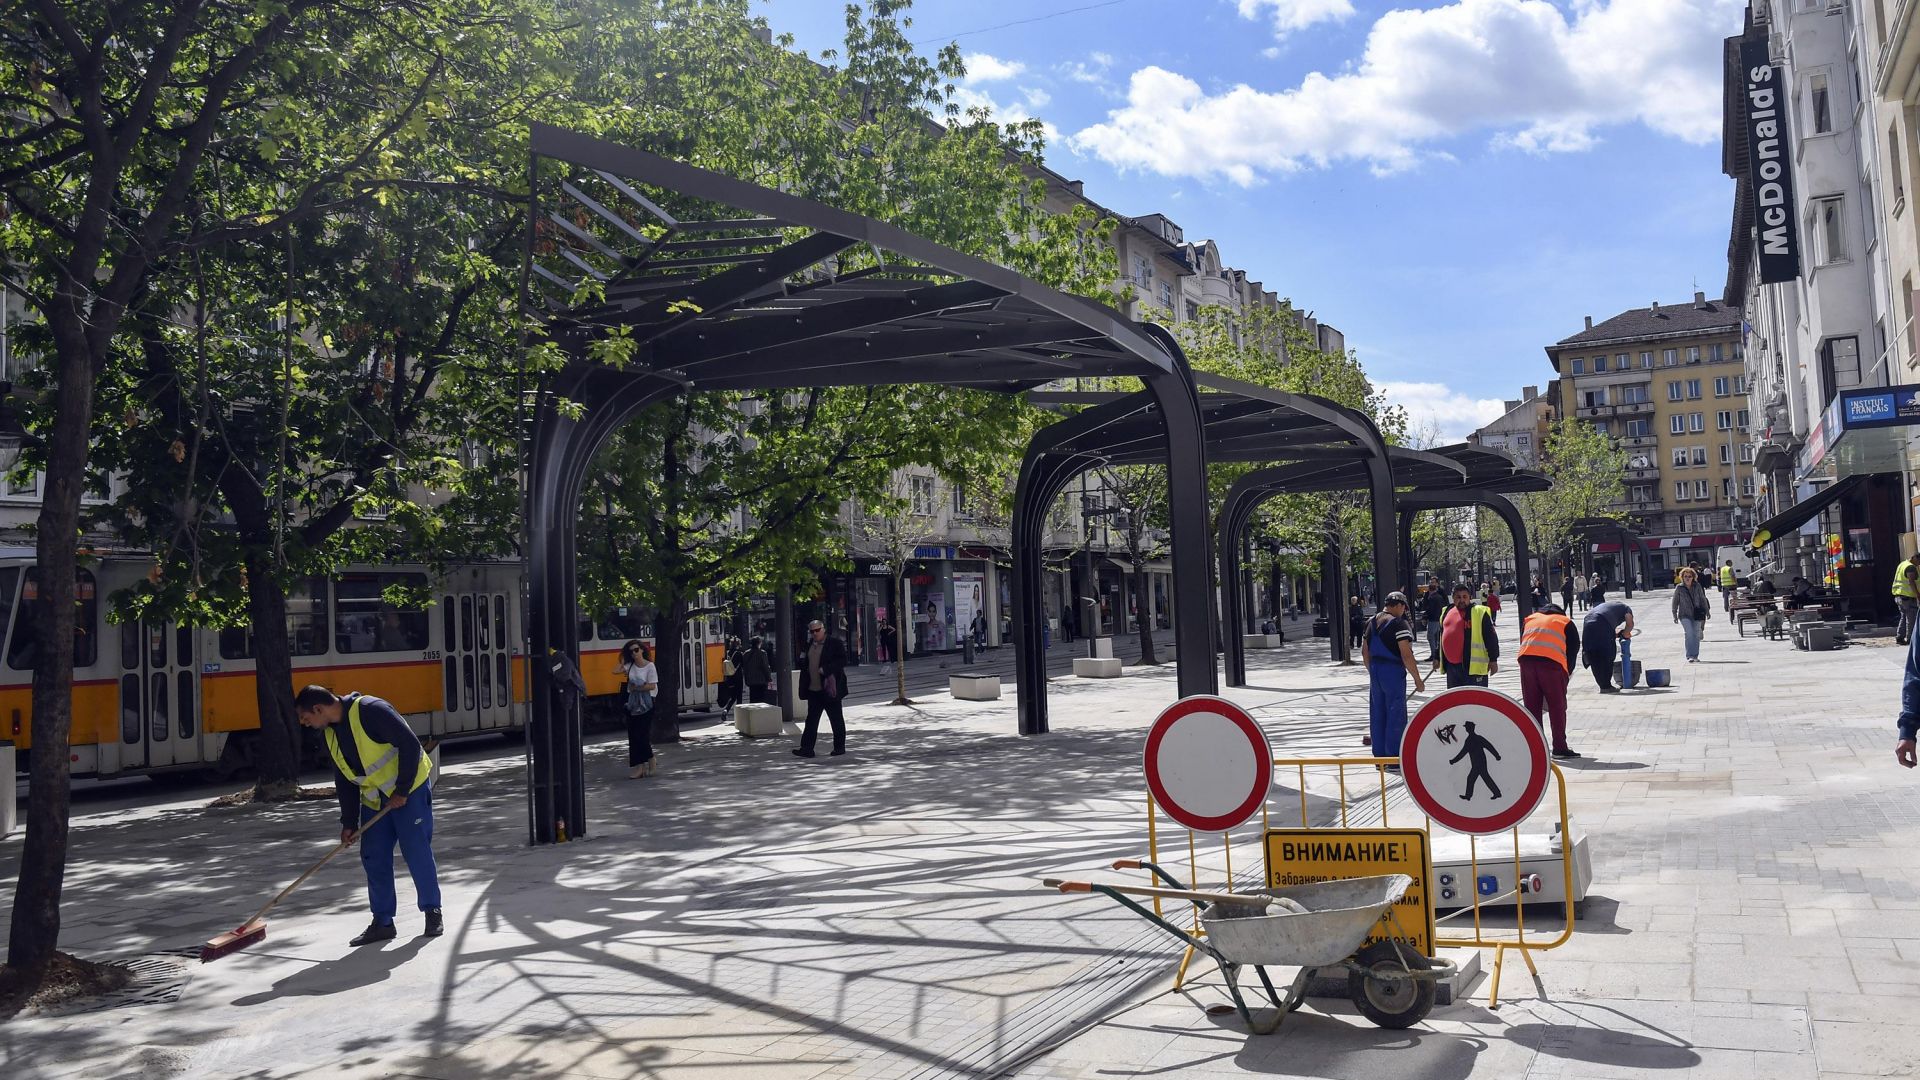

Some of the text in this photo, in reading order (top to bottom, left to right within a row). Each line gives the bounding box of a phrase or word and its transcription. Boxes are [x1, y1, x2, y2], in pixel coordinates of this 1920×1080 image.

[1749, 64, 1788, 255] McDonald's
[1850, 398, 1884, 408] INSTITUT
[1851, 404, 1889, 415] FRANÇAIS
[422, 650, 441, 660] 2055
[1282, 842, 1408, 862] ВНИМАНИЕ!
